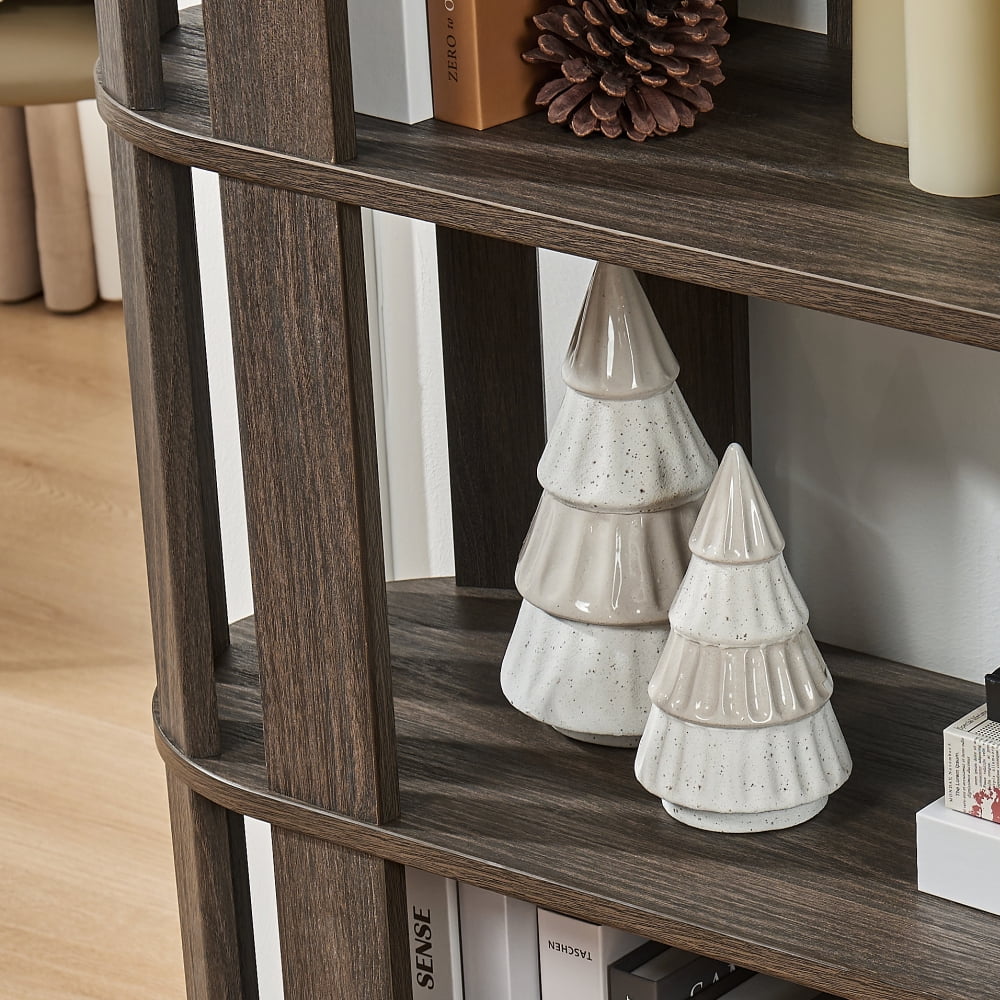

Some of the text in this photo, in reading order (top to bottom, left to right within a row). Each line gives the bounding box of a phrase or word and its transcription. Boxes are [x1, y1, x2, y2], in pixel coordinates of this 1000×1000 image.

[447, 17, 455, 29] to
[446, 35, 458, 82] ZERO
[412, 905, 435, 990] SENSE
[547, 940, 593, 962] TASCHEN
